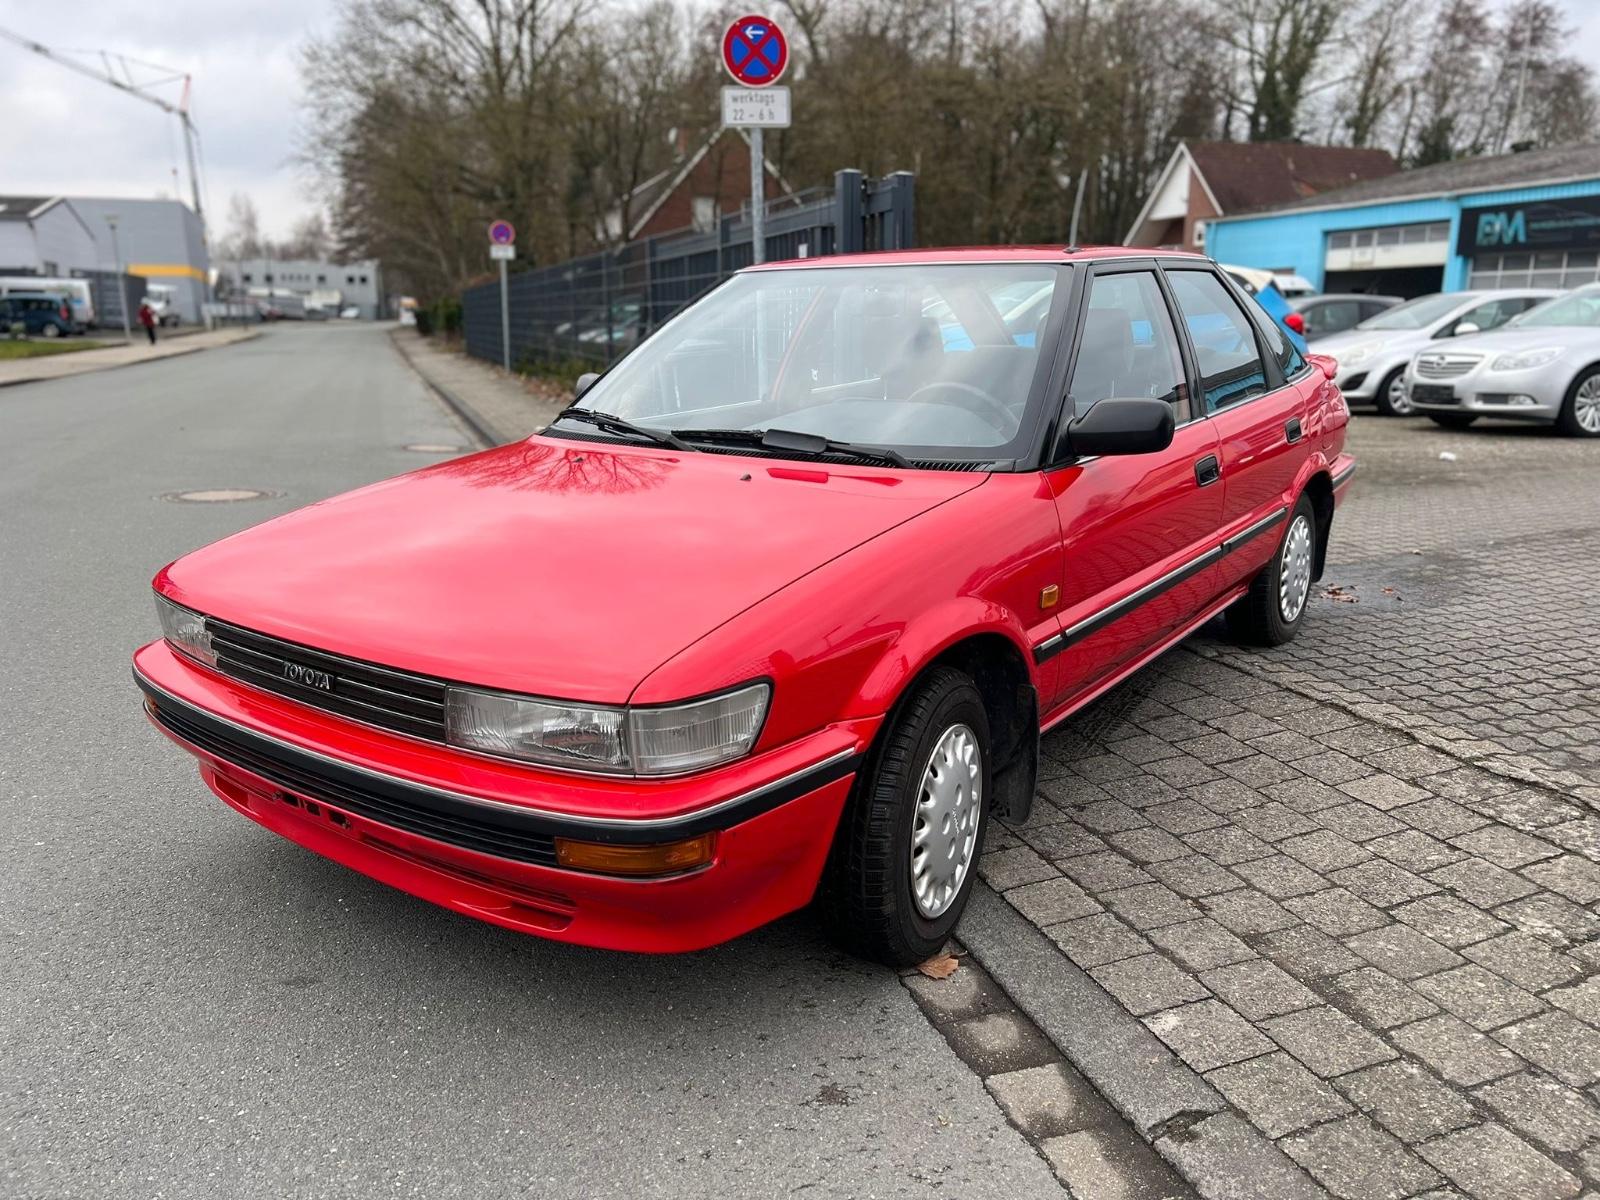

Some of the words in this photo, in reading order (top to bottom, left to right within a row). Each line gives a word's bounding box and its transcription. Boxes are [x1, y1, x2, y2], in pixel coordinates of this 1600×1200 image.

[731, 92, 775, 106] werktags
[733, 108, 745, 121] 22
[759, 108, 765, 121] 6
[769, 108, 775, 121] h
[283, 661, 330, 690] TOYOTA
